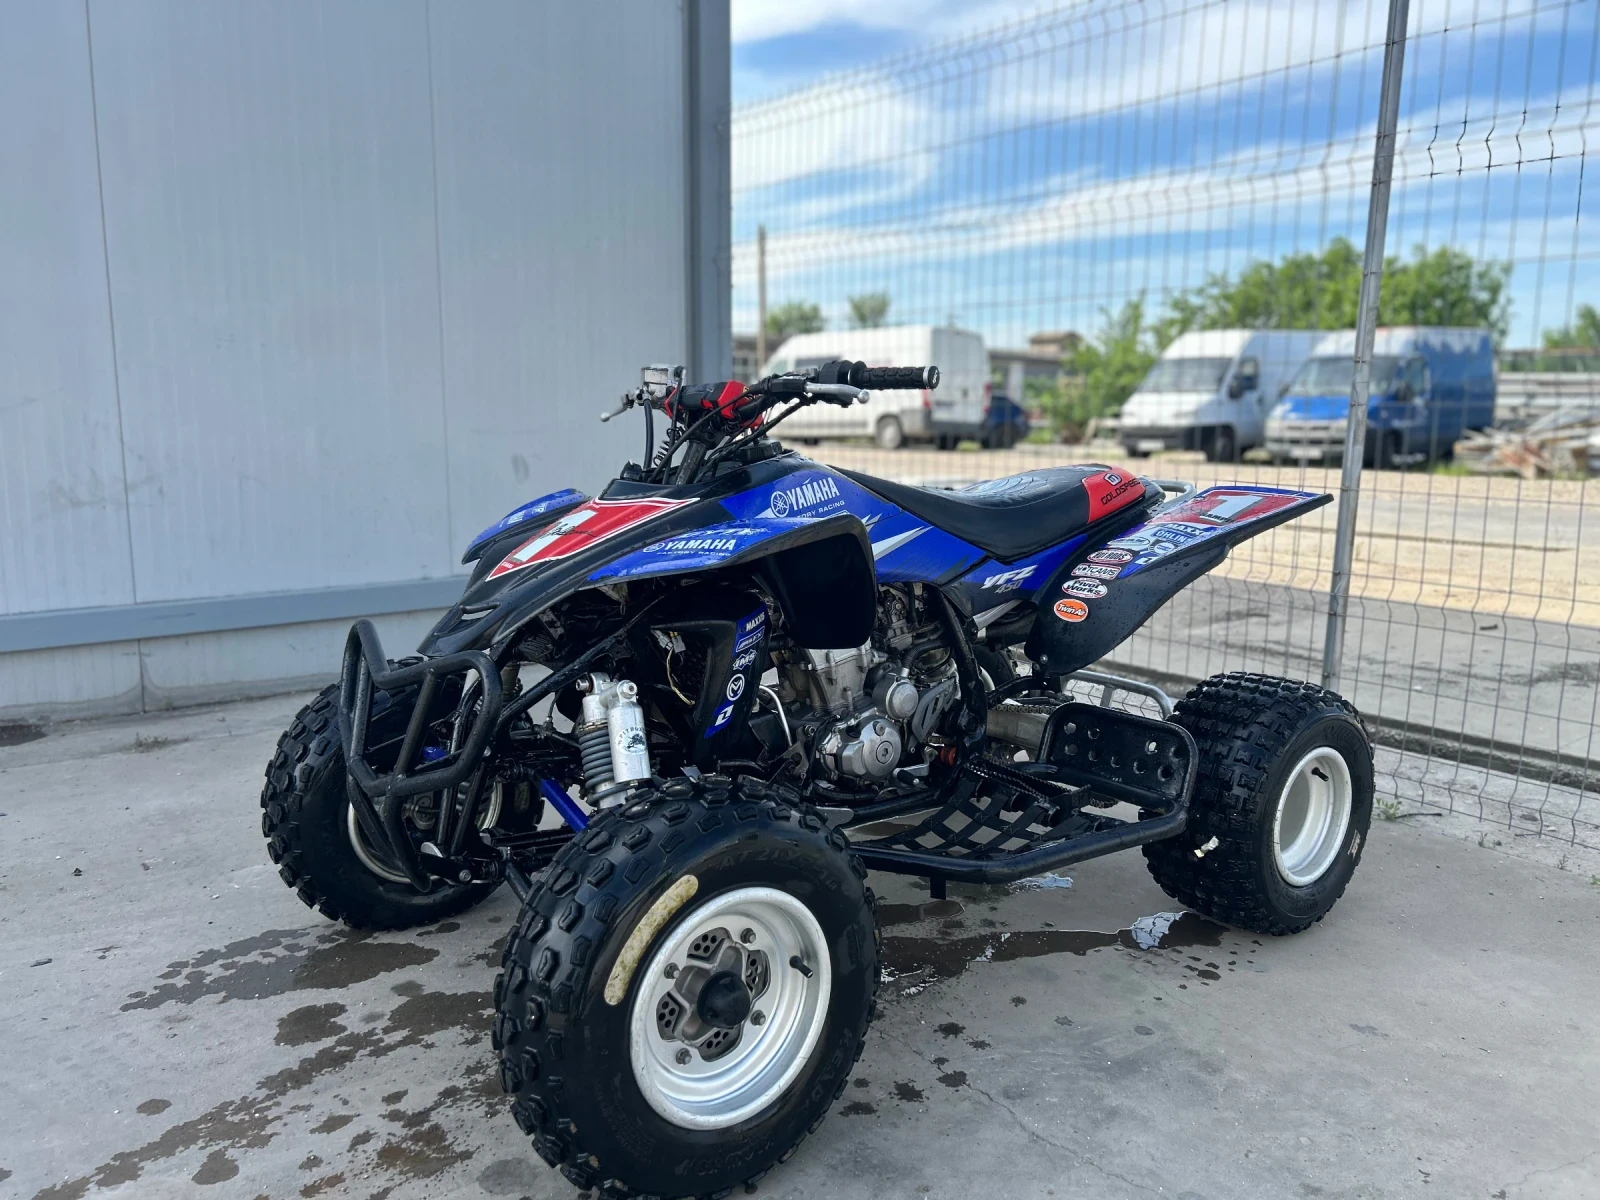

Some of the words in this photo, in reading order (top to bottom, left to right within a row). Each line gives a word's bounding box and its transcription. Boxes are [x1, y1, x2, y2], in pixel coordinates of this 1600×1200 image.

[787, 477, 840, 511] YAMAHA
[818, 500, 846, 513] RACING
[664, 539, 737, 551] YAMAHA
[980, 564, 1038, 589] YFZ
[994, 579, 1023, 594] 450
[1066, 585, 1102, 595] Works
[1072, 579, 1101, 588] Pivot
[1057, 603, 1075, 613] Twin
[1075, 608, 1086, 616] Air
